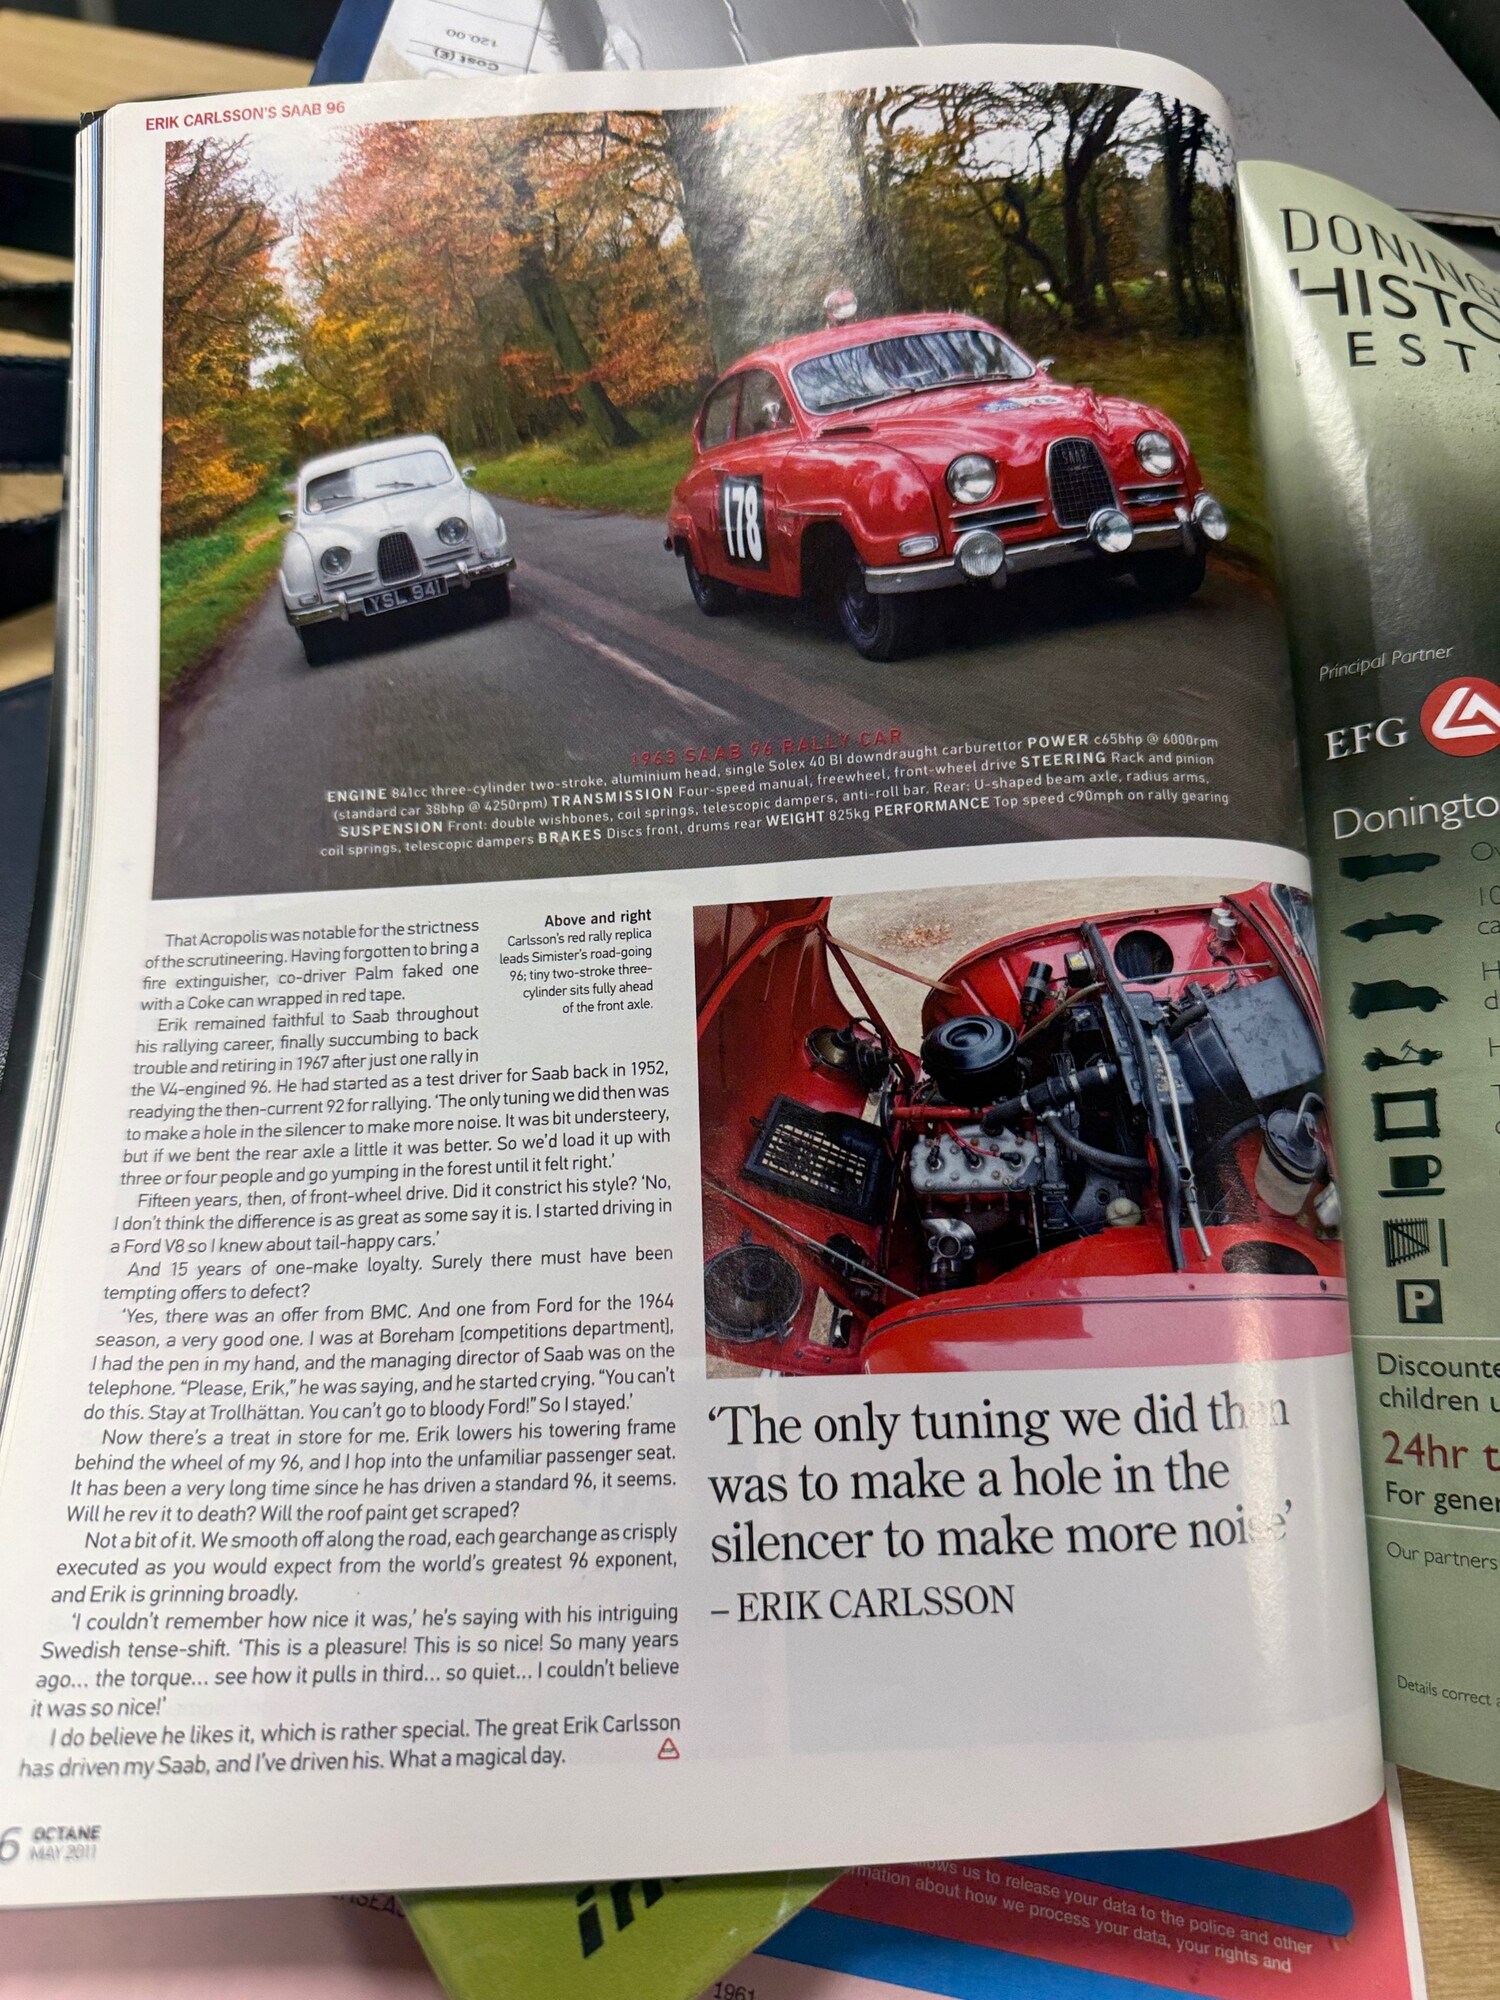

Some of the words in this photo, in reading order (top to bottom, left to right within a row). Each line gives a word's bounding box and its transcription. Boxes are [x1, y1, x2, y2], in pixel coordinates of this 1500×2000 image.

[459, 55, 500, 72] Cost
[145, 116, 180, 131] ERIK
[183, 106, 277, 127] CARLSSON'S
[281, 102, 321, 118] SAAB
[326, 101, 345, 114] 96
[1280, 208, 1500, 308] DONING
[724, 485, 763, 562] 178
[369, 591, 408, 611] YSL
[412, 579, 443, 600] 941
[1319, 652, 1386, 682] Principal
[1391, 646, 1454, 666] Partner
[631, 750, 677, 768] 1963
[684, 743, 743, 764] SAAB
[750, 740, 773, 758] 96
[781, 732, 850, 755] RALLY
[859, 728, 902, 748] CAR
[1324, 717, 1409, 761] EFG
[326, 787, 387, 803] ENGINE
[391, 787, 428, 800] 841cc
[431, 781, 526, 797] three-cylinder
[530, 775, 607, 792] two-stroke,
[611, 770, 681, 786] aluminium
[684, 766, 721, 780] head,
[725, 761, 764, 777] single
[768, 758, 804, 772] Solex
[809, 755, 825, 768] 40
[847, 744, 938, 765] downdraught
[942, 737, 1022, 756] carburettor
[1026, 732, 1089, 751] POWER
[1094, 733, 1143, 749] c65bhp
[1162, 734, 1218, 750] 6000rpm
[1333, 793, 1500, 840] Doningto
[166, 933, 197, 947] That
[200, 930, 267, 948] Acropolis
[270, 931, 300, 943] was
[303, 926, 357, 941] notable
[359, 924, 380, 938] for
[382, 923, 405, 937] the
[407, 920, 480, 936] strictness
[544, 914, 587, 928] Above
[590, 911, 616, 926] and
[620, 908, 652, 928] right
[507, 932, 565, 948] Carlsson’s
[568, 930, 586, 943] red
[589, 928, 613, 945] rally
[614, 925, 653, 944] replica
[500, 951, 530, 966] leads
[532, 948, 587, 963] Simister’s
[591, 944, 653, 962] road-going
[509, 969, 527, 983] 96;
[530, 968, 551, 983] tiny
[552, 964, 615, 980] two-stroke
[618, 961, 653, 976] three-
[522, 985, 568, 1001] cylinder
[570, 984, 590, 996] sits
[593, 981, 617, 998] fully
[619, 978, 654, 994] ahead
[562, 1001, 575, 1014] of
[576, 1001, 595, 1013] the
[597, 999, 625, 1012] front
[626, 997, 654, 1011] axle.
[1379, 1385, 1479, 1412] children
[709, 1402, 802, 1446] ‘The
[814, 1399, 901, 1450] only
[911, 1398, 1051, 1446] tuning
[1060, 1405, 1121, 1436] we
[1133, 1392, 1199, 1434] did
[1382, 1430, 1469, 1469] 24hr
[70, 1479, 83, 1496] It
[88, 1479, 118, 1496] has
[124, 1479, 166, 1496] been
[171, 1483, 182, 1496] a
[187, 1483, 225, 1501] very
[230, 1479, 267, 1501] long
[271, 1479, 310, 1496] time
[315, 1478, 359, 1495] since
[363, 1477, 385, 1494] he
[389, 1476, 418, 1494] has
[424, 1475, 475, 1493] driven
[480, 1479, 491, 1492] a
[495, 1472, 568, 1492] standard
[573, 1472, 597, 1491] 96,
[602, 1471, 613, 1487] it
[617, 1473, 677, 1487] seems.
[708, 1472, 788, 1504] was
[798, 1464, 838, 1502] to
[850, 1457, 965, 1500] make
[978, 1466, 1001, 1497] a
[1009, 1453, 1102, 1496] hole
[1113, 1452, 1154, 1493] in
[1164, 1449, 1230, 1491] the
[1386, 1480, 1425, 1505] For
[711, 1519, 873, 1564] silencer
[884, 1520, 925, 1559] to
[936, 1513, 1054, 1556] make
[1066, 1518, 1177, 1554] more
[1386, 1541, 1420, 1560] Our
[1424, 1550, 1498, 1571] partners
[737, 1590, 822, 1623] ERIK
[829, 1584, 1015, 1620] CARLSSON
[1397, 1674, 1438, 1697] Details
[1441, 1689, 1492, 1706] correct
[49, 1730, 56, 1747] I
[61, 1729, 85, 1747] do
[89, 1727, 157, 1746] believe
[161, 1726, 186, 1745] he
[190, 1724, 233, 1744] likes
[238, 1724, 255, 1745] it,
[261, 1722, 316, 1742] which
[321, 1722, 336, 1740] is
[340, 1721, 398, 1740] rather
[401, 1718, 470, 1744] special.
[474, 1717, 508, 1737] The
[512, 1719, 559, 1741] great
[563, 1714, 599, 1734] Erik
[602, 1712, 681, 1734] Carlsson
[33, 1824, 102, 1842] OCTANE
[914, 1877, 961, 1899] about
[965, 1884, 998, 1906] how
[1002, 1896, 1025, 1912] we
[1029, 1902, 1091, 1929] process
[1094, 1916, 1129, 1937] your
[1133, 1926, 1171, 1949] data,
[1176, 1936, 1210, 1956] your
[1214, 1942, 1259, 1964] rights
[1263, 1954, 1292, 1973] and
[962, 1866, 981, 1880] us
[986, 1868, 1001, 1885] to
[1005, 1873, 1061, 1898] release
[1065, 1885, 1098, 1908] your
[1102, 1897, 1137, 1918] data
[1141, 1904, 1156, 1921] to
[1161, 1909, 1185, 1927] the
[1189, 1917, 1236, 1939] police
[1240, 1925, 1269, 1946] and
[1273, 1936, 1313, 1956] other
